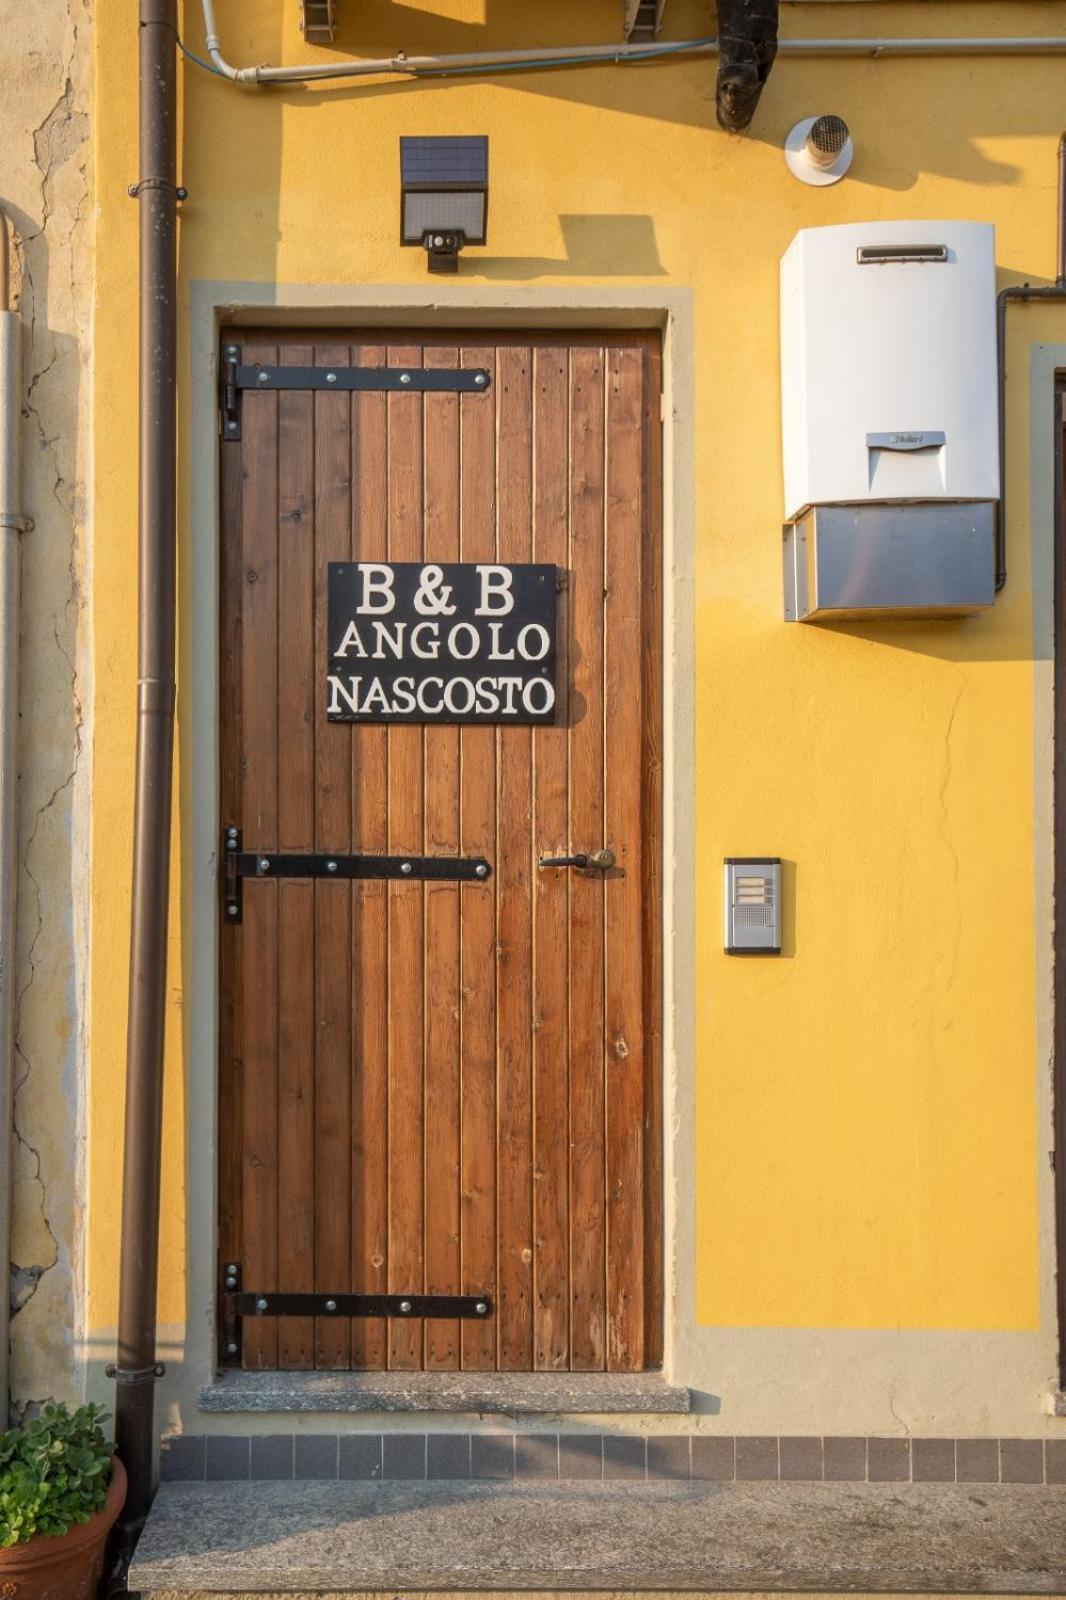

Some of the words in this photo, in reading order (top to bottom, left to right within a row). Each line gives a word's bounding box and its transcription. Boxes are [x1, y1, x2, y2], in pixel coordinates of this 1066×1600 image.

[356, 564, 395, 614] B
[414, 565, 456, 616] &
[475, 565, 514, 616] B
[334, 621, 550, 660] ANGOLO
[327, 676, 554, 714] NASCOSTO
